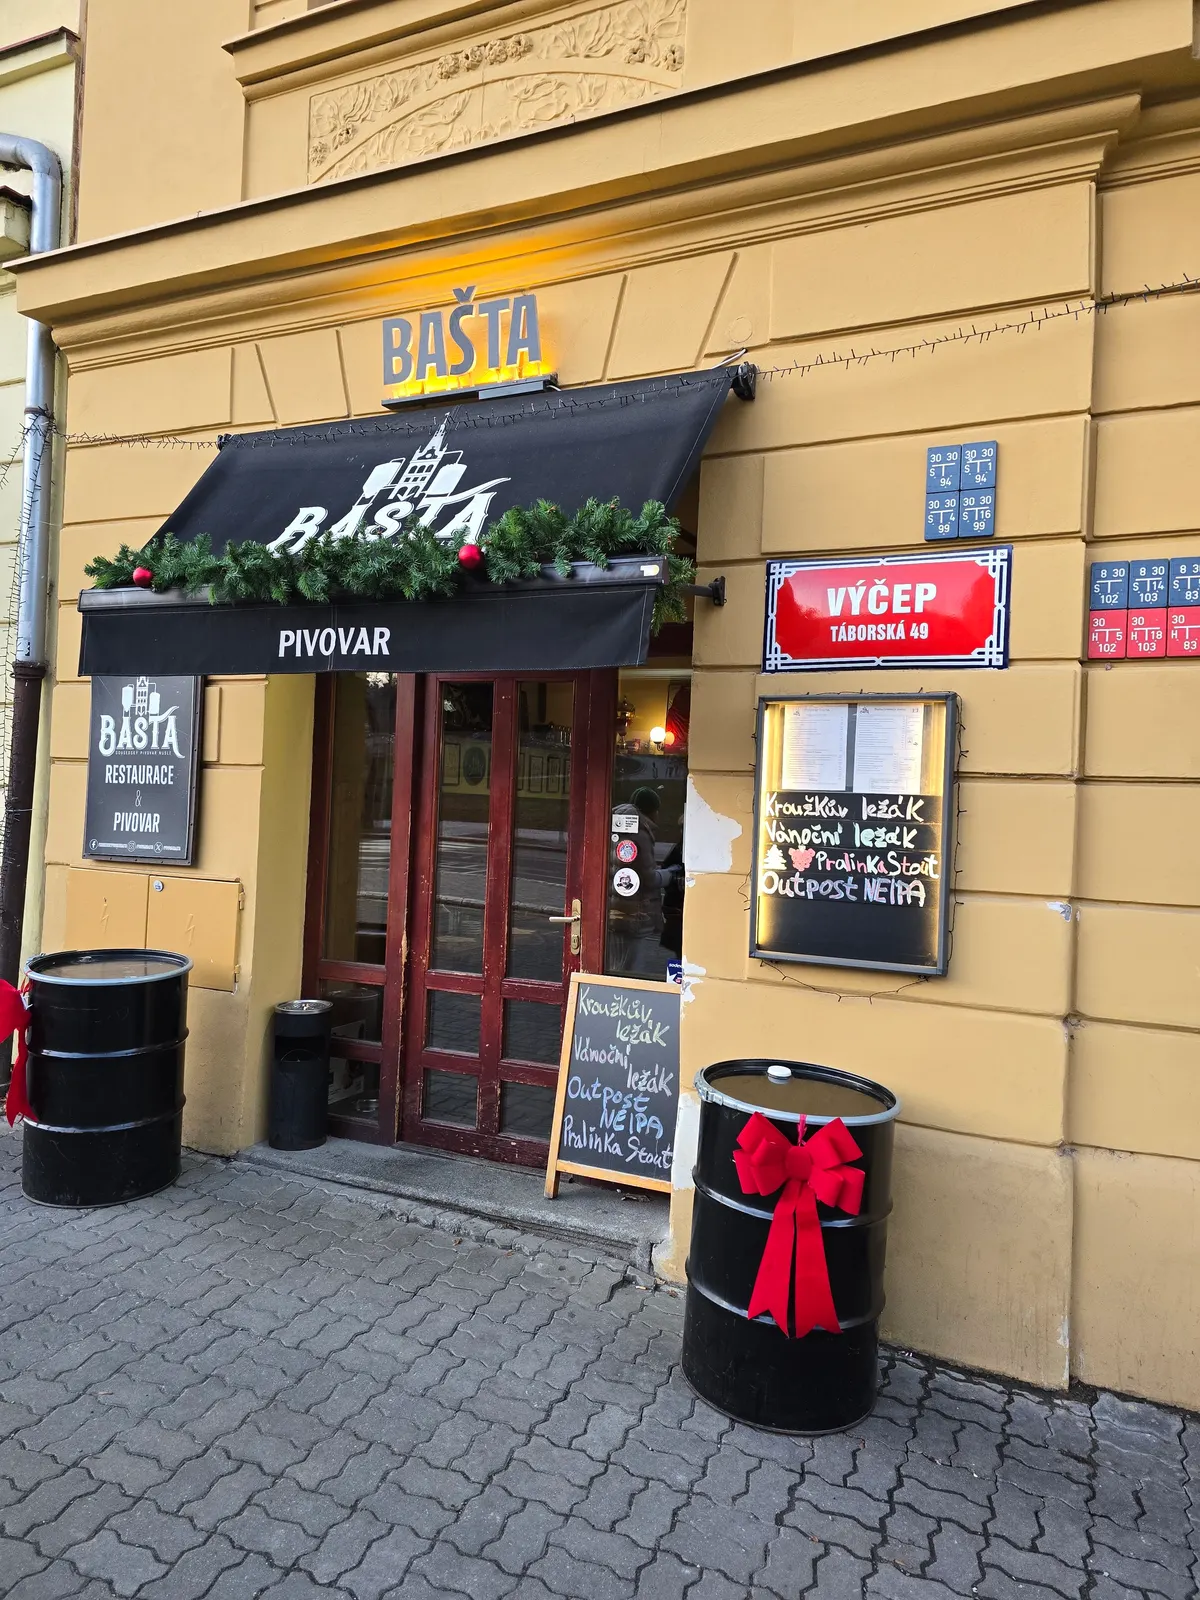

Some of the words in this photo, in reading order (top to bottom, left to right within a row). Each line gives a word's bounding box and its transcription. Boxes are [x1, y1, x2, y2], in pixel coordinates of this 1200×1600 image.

[382, 286, 541, 385] BAŠTA
[930, 454, 941, 463] 30
[946, 452, 958, 461] 30
[965, 450, 976, 459] 30
[982, 448, 994, 457] 30
[928, 500, 940, 509] 30
[944, 499, 956, 508] 30
[963, 497, 975, 506] 30
[980, 495, 992, 504] 30
[1101, 569, 1107, 578] 8
[1112, 568, 1125, 577] 30
[1139, 567, 1146, 576] 8
[1152, 566, 1165, 575] 30
[1180, 565, 1187, 573] 8
[1192, 564, 1200, 573] 3
[827, 578, 937, 617] VÝČEP
[1093, 618, 1105, 627] 30
[1132, 617, 1144, 625] 30
[1172, 615, 1184, 624] 30
[830, 620, 905, 642] TÁBORSKÁ
[910, 623, 929, 639] 49
[278, 627, 391, 657] PIVOVAR
[105, 764, 174, 785] RESTAURACE
[135, 790, 142, 807] &
[113, 812, 160, 833] PIVOVAR
[765, 820, 843, 845] Vánoční
[761, 871, 858, 901] Outpost
[863, 878, 926, 907] NEIPA
[567, 1076, 650, 1113] Outpost
